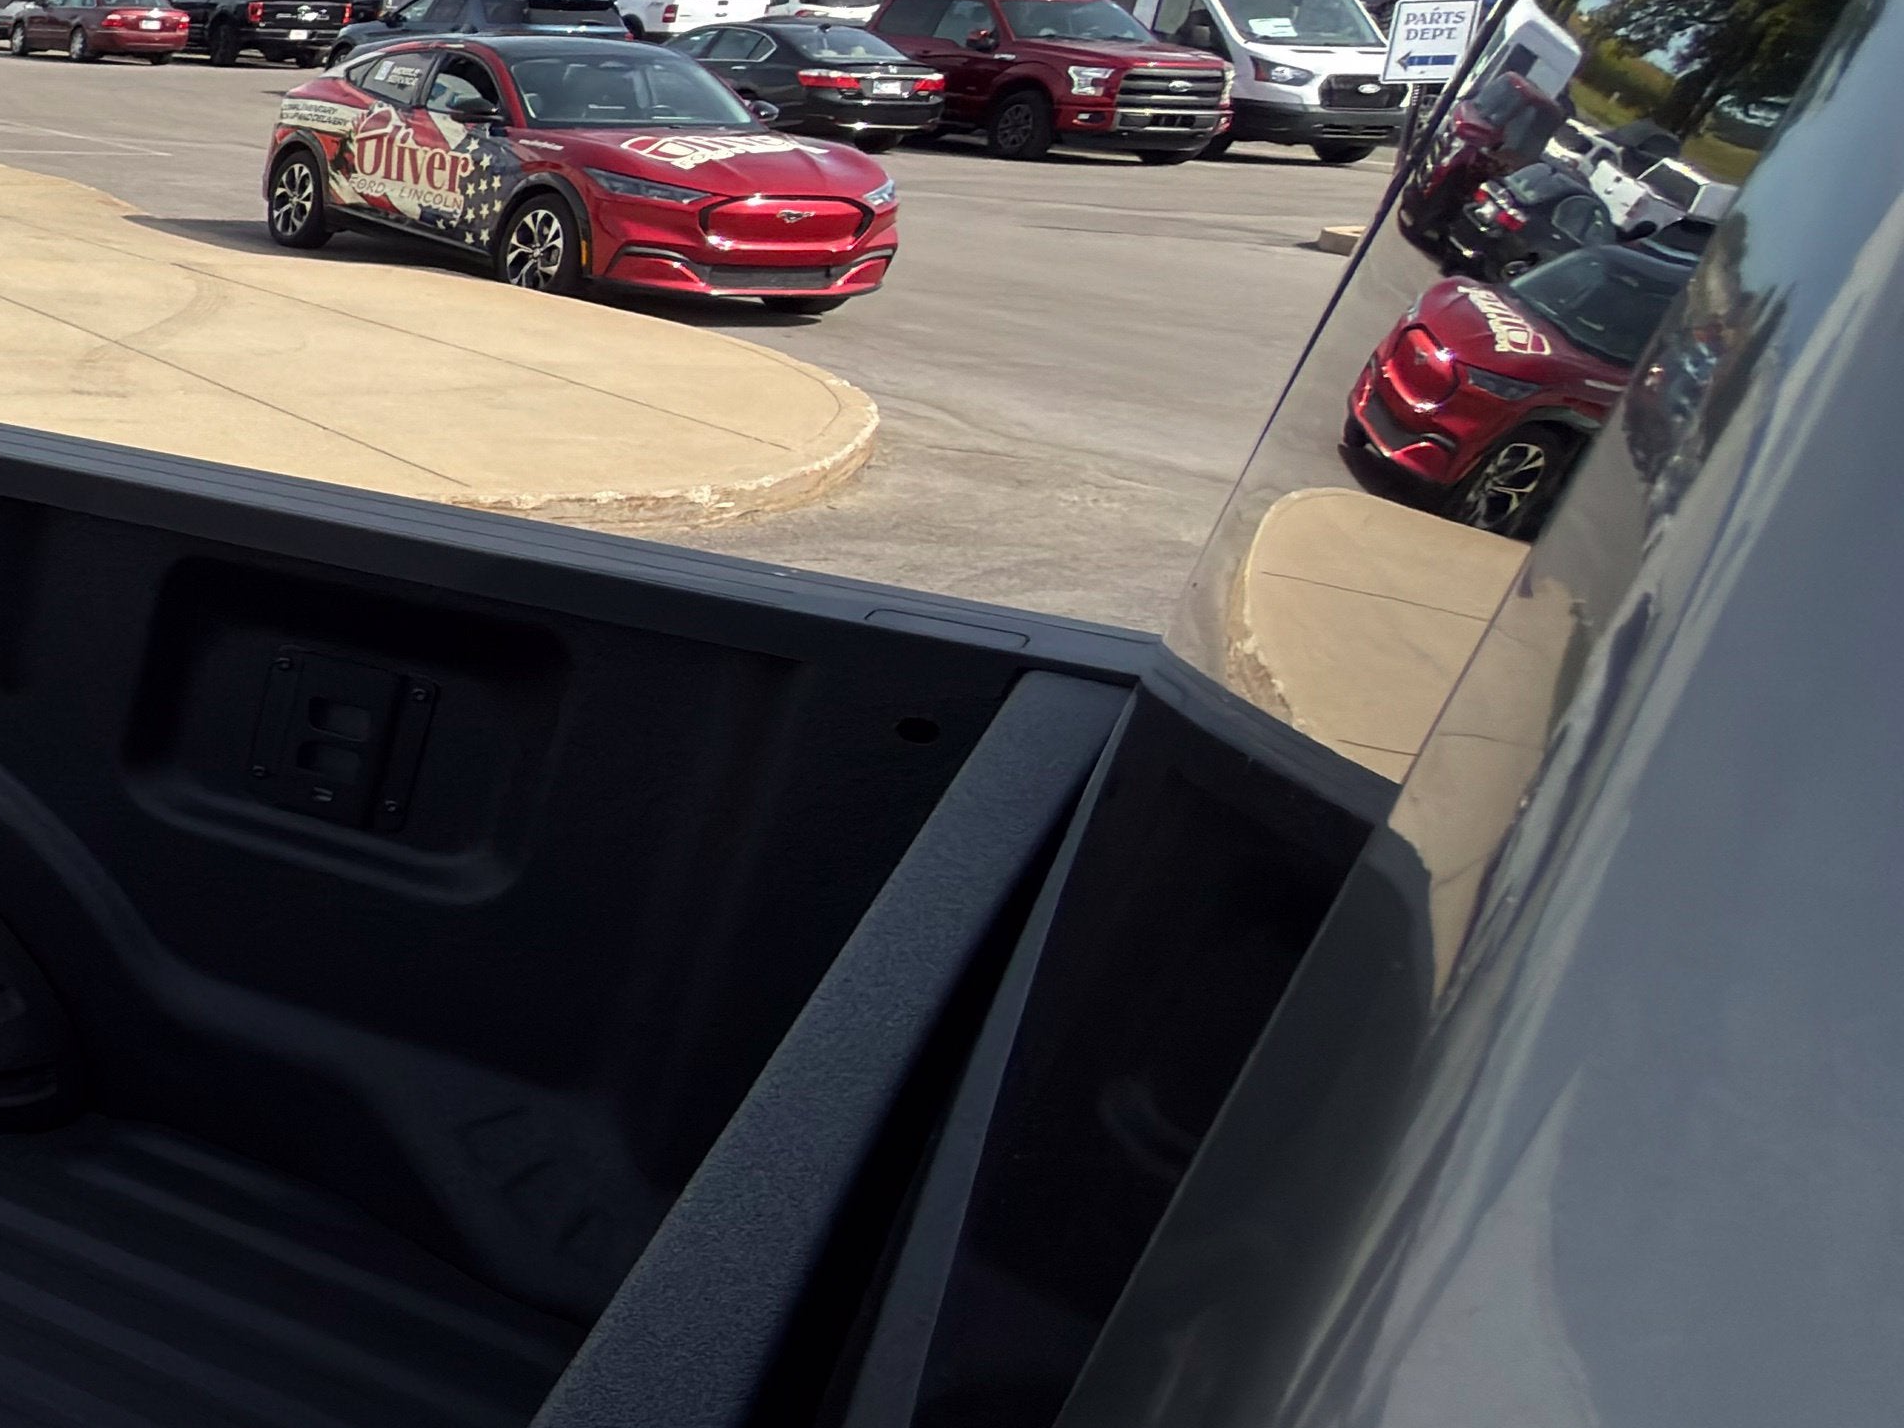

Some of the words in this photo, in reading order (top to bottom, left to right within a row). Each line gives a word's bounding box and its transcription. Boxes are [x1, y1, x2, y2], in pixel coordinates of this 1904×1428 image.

[1404, 10, 1466, 25] PARTS
[356, 109, 472, 193] Oliver
[350, 175, 386, 194] FORD
[399, 186, 463, 209] LINCOLN
